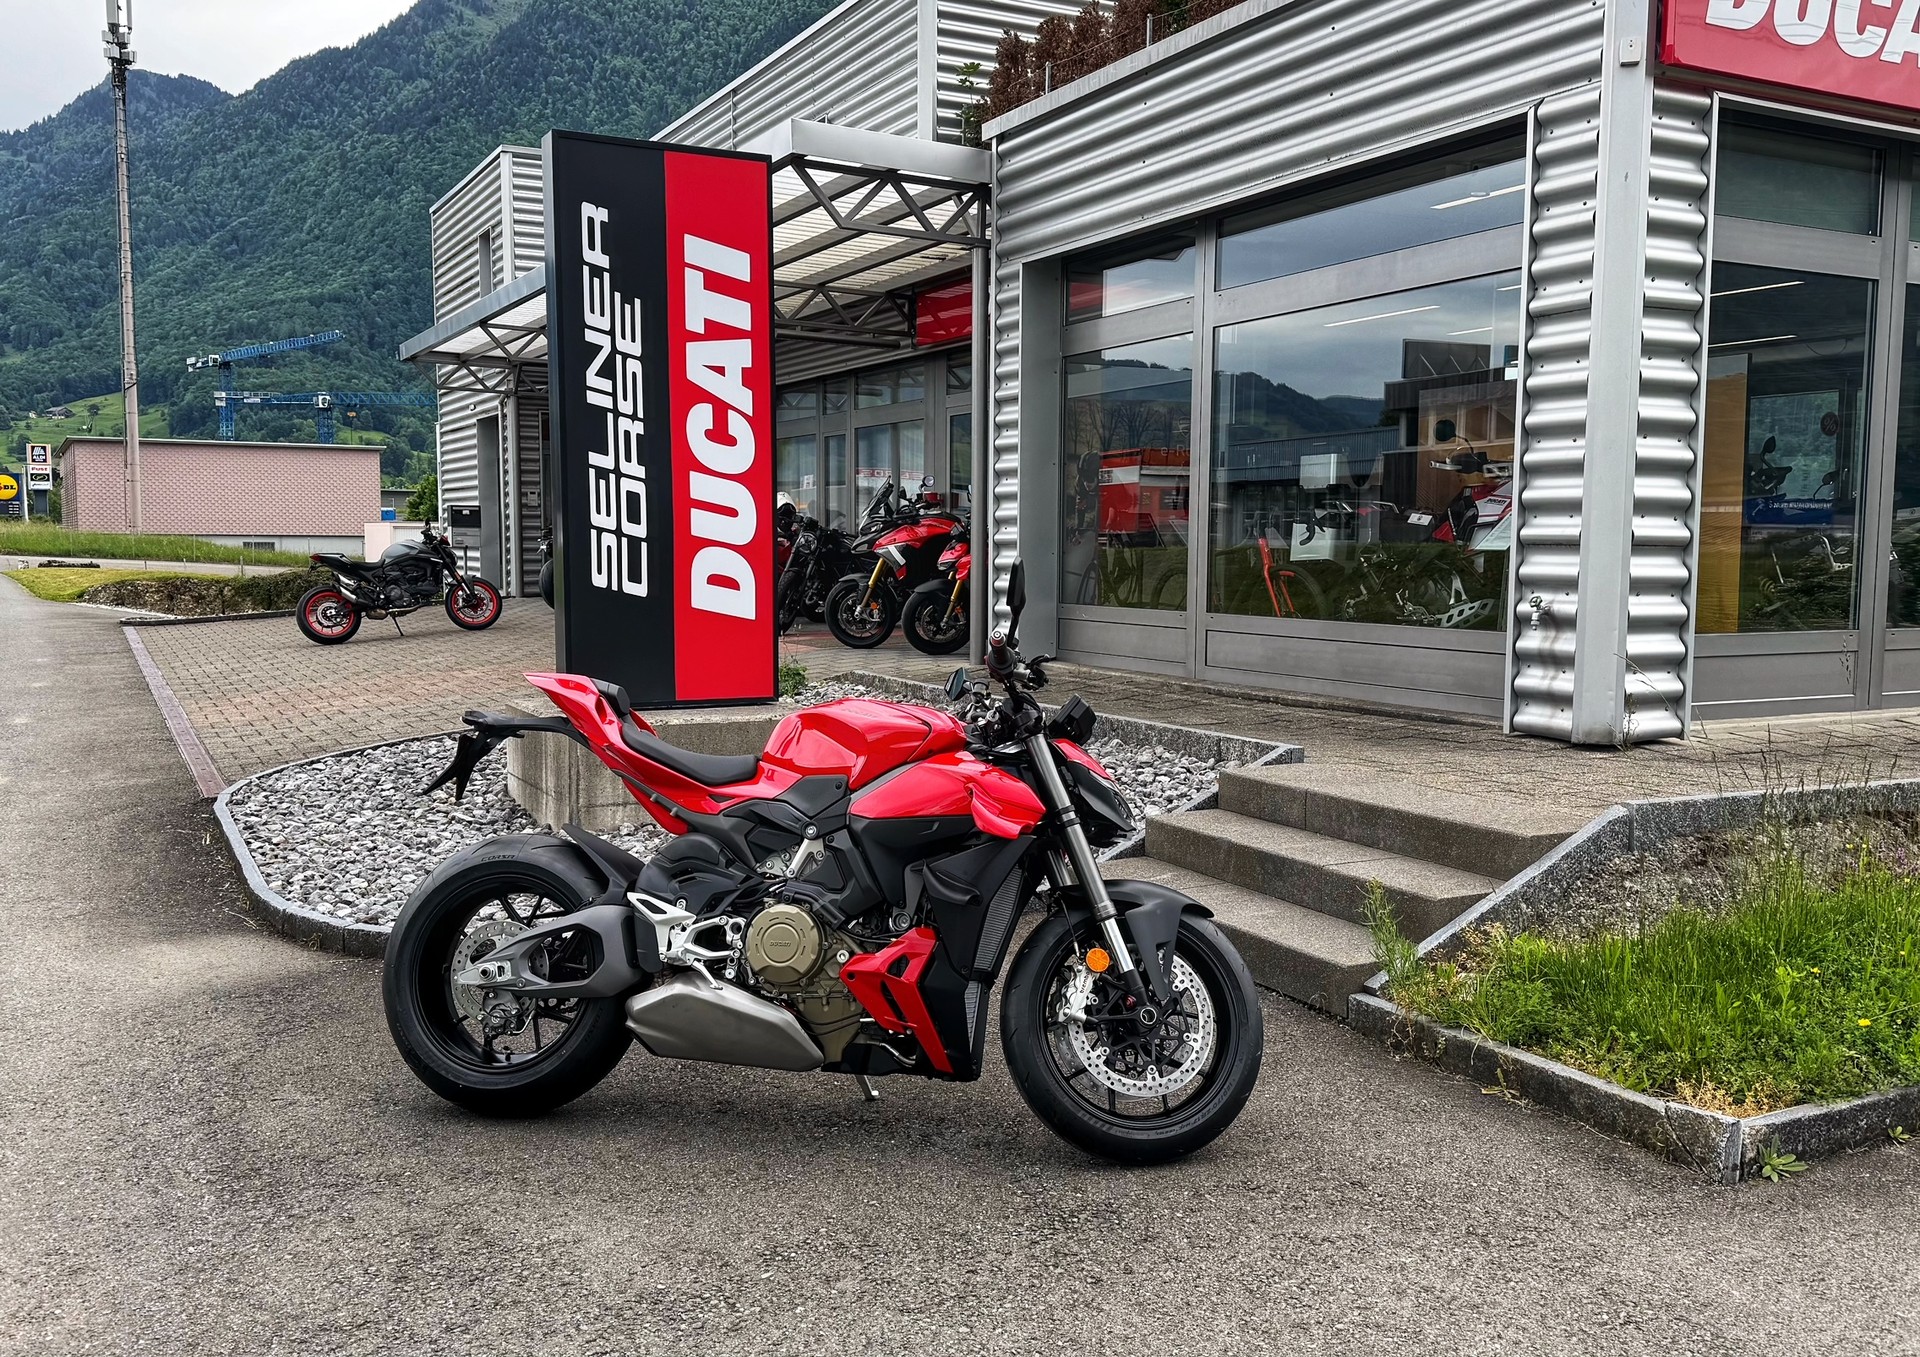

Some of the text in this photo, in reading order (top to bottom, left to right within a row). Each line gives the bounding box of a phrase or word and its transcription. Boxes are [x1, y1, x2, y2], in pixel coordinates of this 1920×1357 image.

[581, 201, 618, 592] SELINER
[614, 291, 648, 598] CORSE
[684, 233, 757, 620] DUCATI
[1079, 971, 1090, 994] brembo
